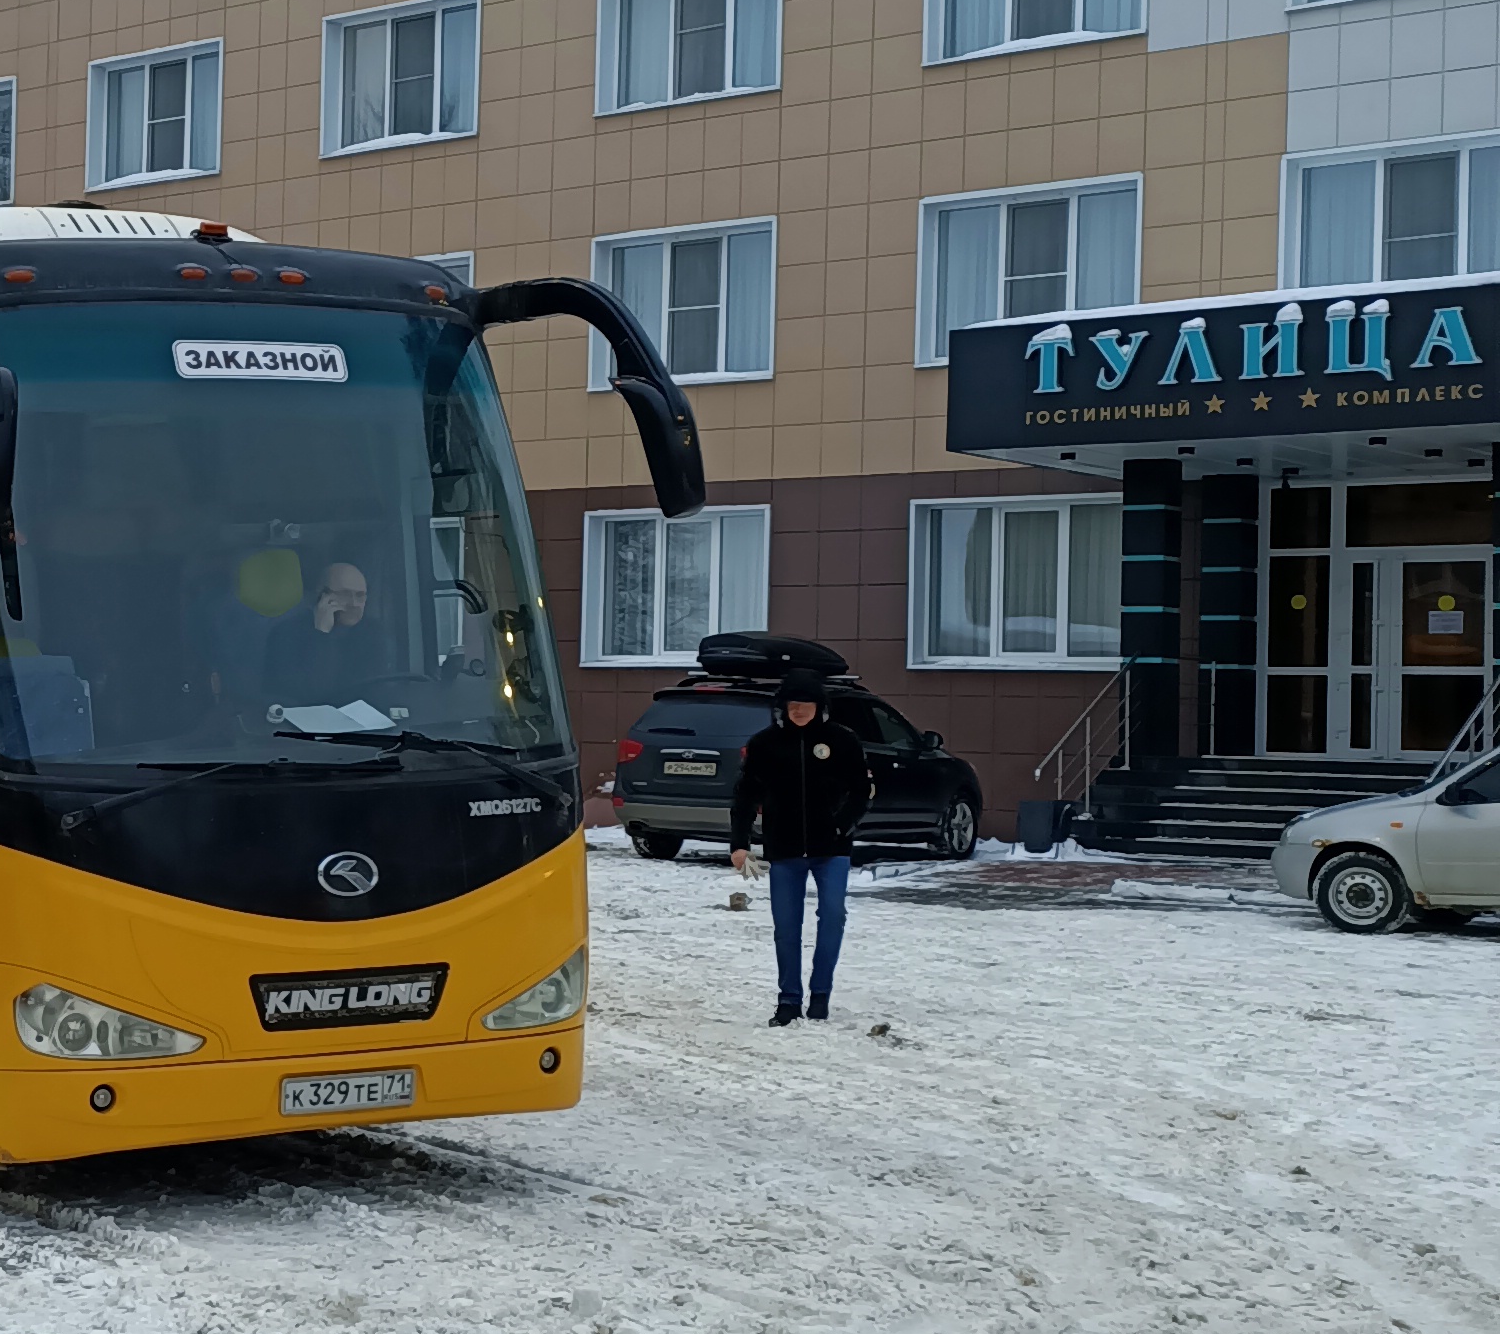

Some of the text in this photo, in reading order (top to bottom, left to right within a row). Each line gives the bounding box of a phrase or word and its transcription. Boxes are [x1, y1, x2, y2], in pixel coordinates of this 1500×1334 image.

[184, 348, 339, 373] ЗАКАЗНОЙ
[1024, 305, 1484, 394] ТУЛИЦА
[1025, 383, 1485, 426] ГОСТИНИЧНЫЙ КОМПЛЕКС
[468, 798, 542, 817] XMQ6127C
[266, 981, 432, 1014] KING LONG
